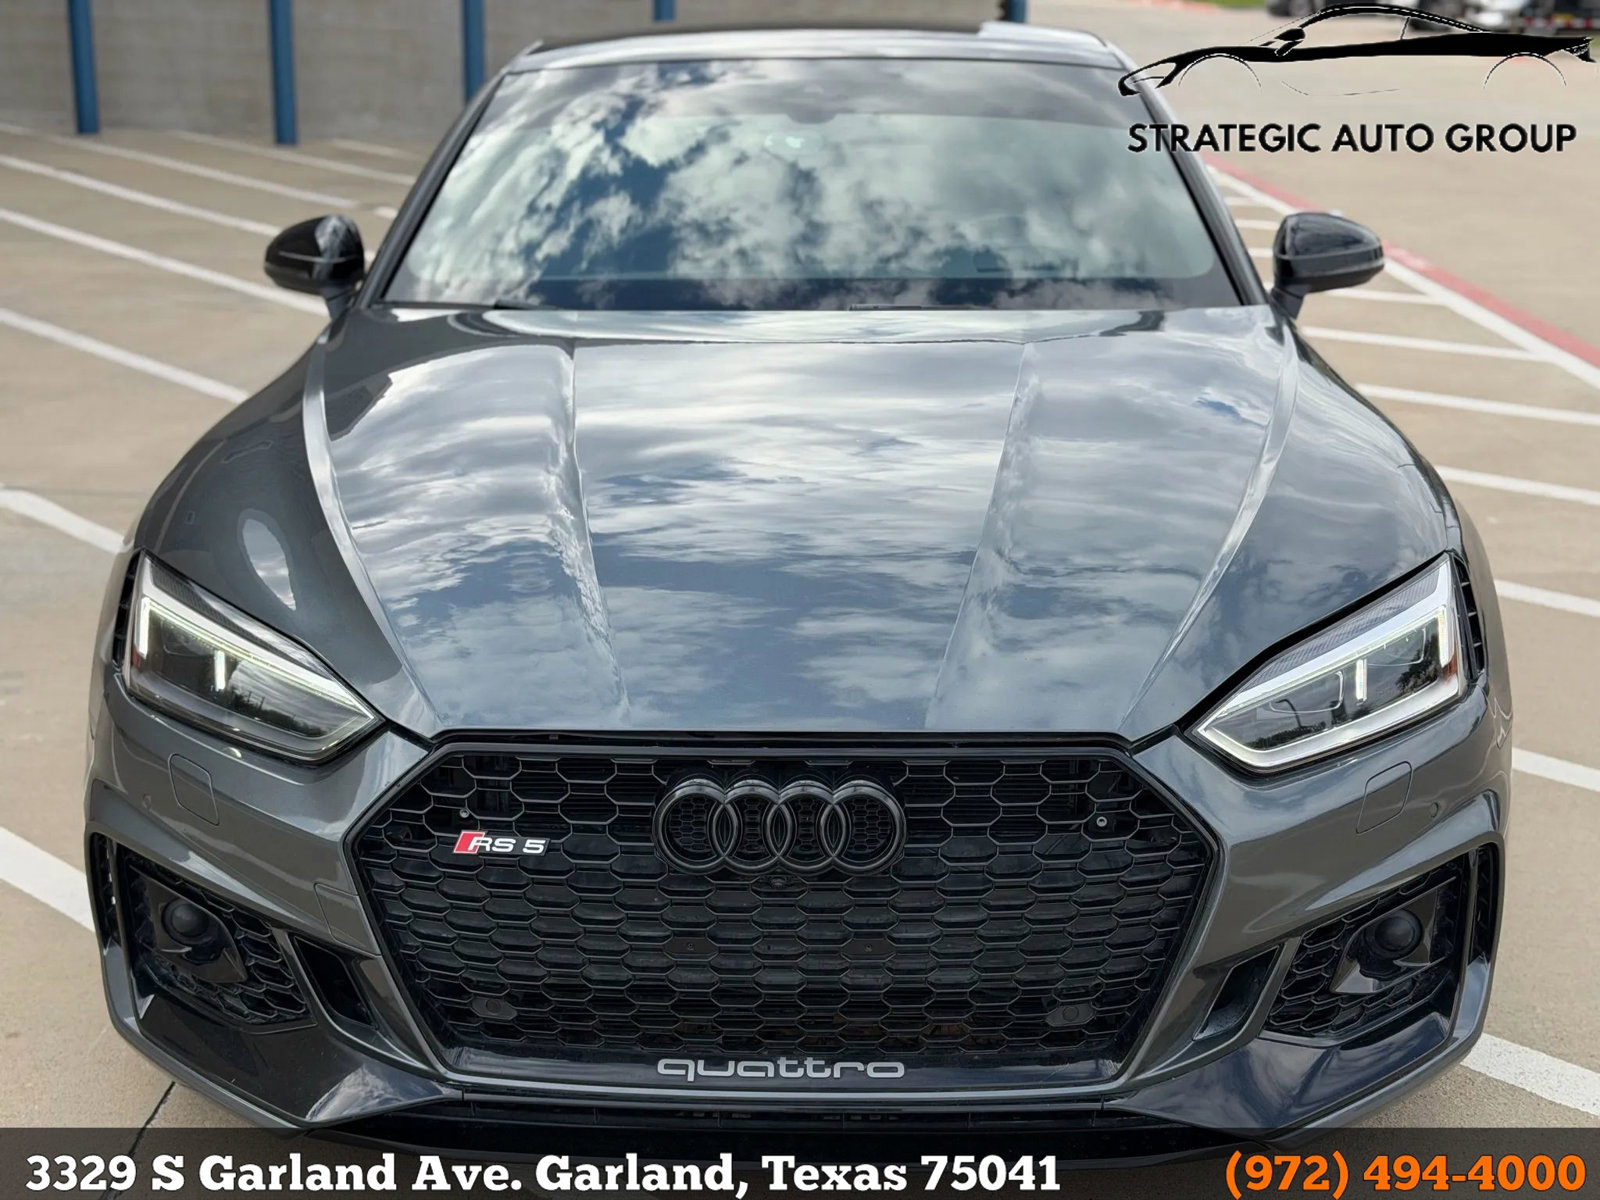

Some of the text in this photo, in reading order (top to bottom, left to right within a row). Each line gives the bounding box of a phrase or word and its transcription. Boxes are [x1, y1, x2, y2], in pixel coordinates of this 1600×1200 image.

[467, 837, 546, 854] RS 5
[657, 1057, 905, 1082] quattro
